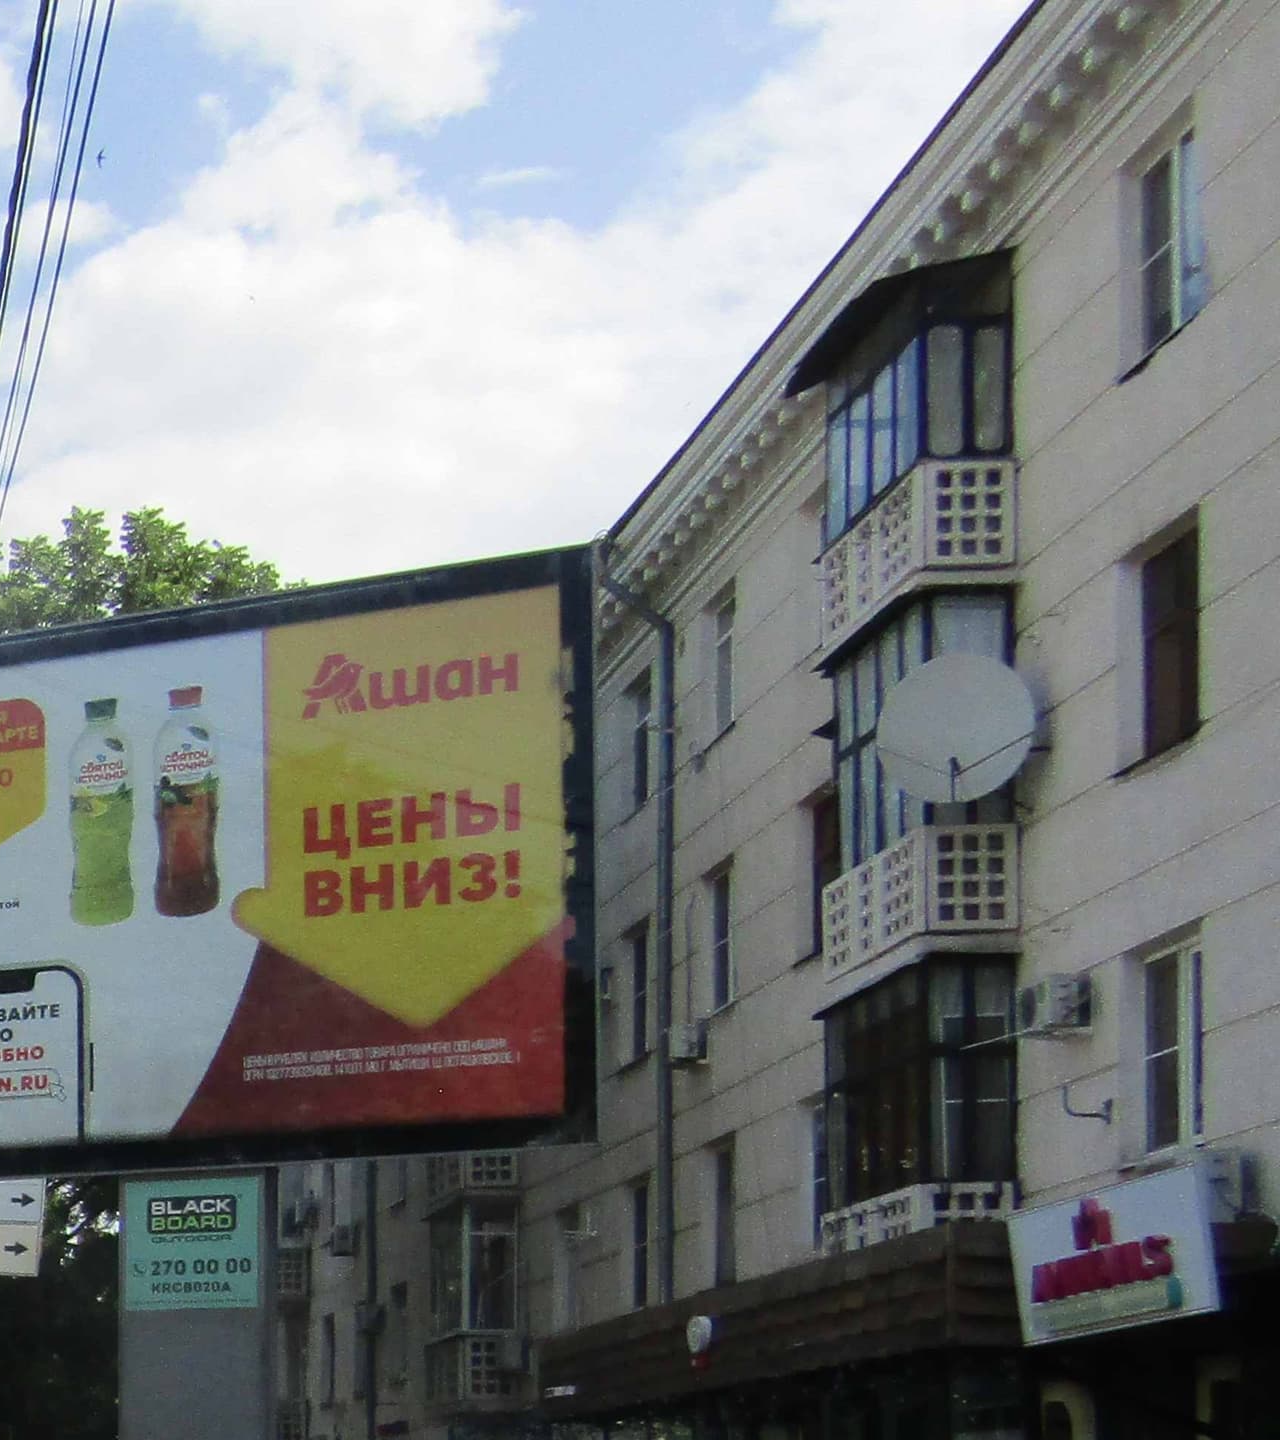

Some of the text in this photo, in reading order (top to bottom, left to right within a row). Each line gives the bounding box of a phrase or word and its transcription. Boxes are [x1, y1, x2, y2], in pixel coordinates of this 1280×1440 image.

[303, 782, 521, 860] ЦЕНЫ
[304, 850, 521, 918] ВНИЗ!
[151, 1199, 232, 1215] BLACK
[151, 1214, 232, 1231] BOARD
[151, 1258, 251, 1276] 270 00 00
